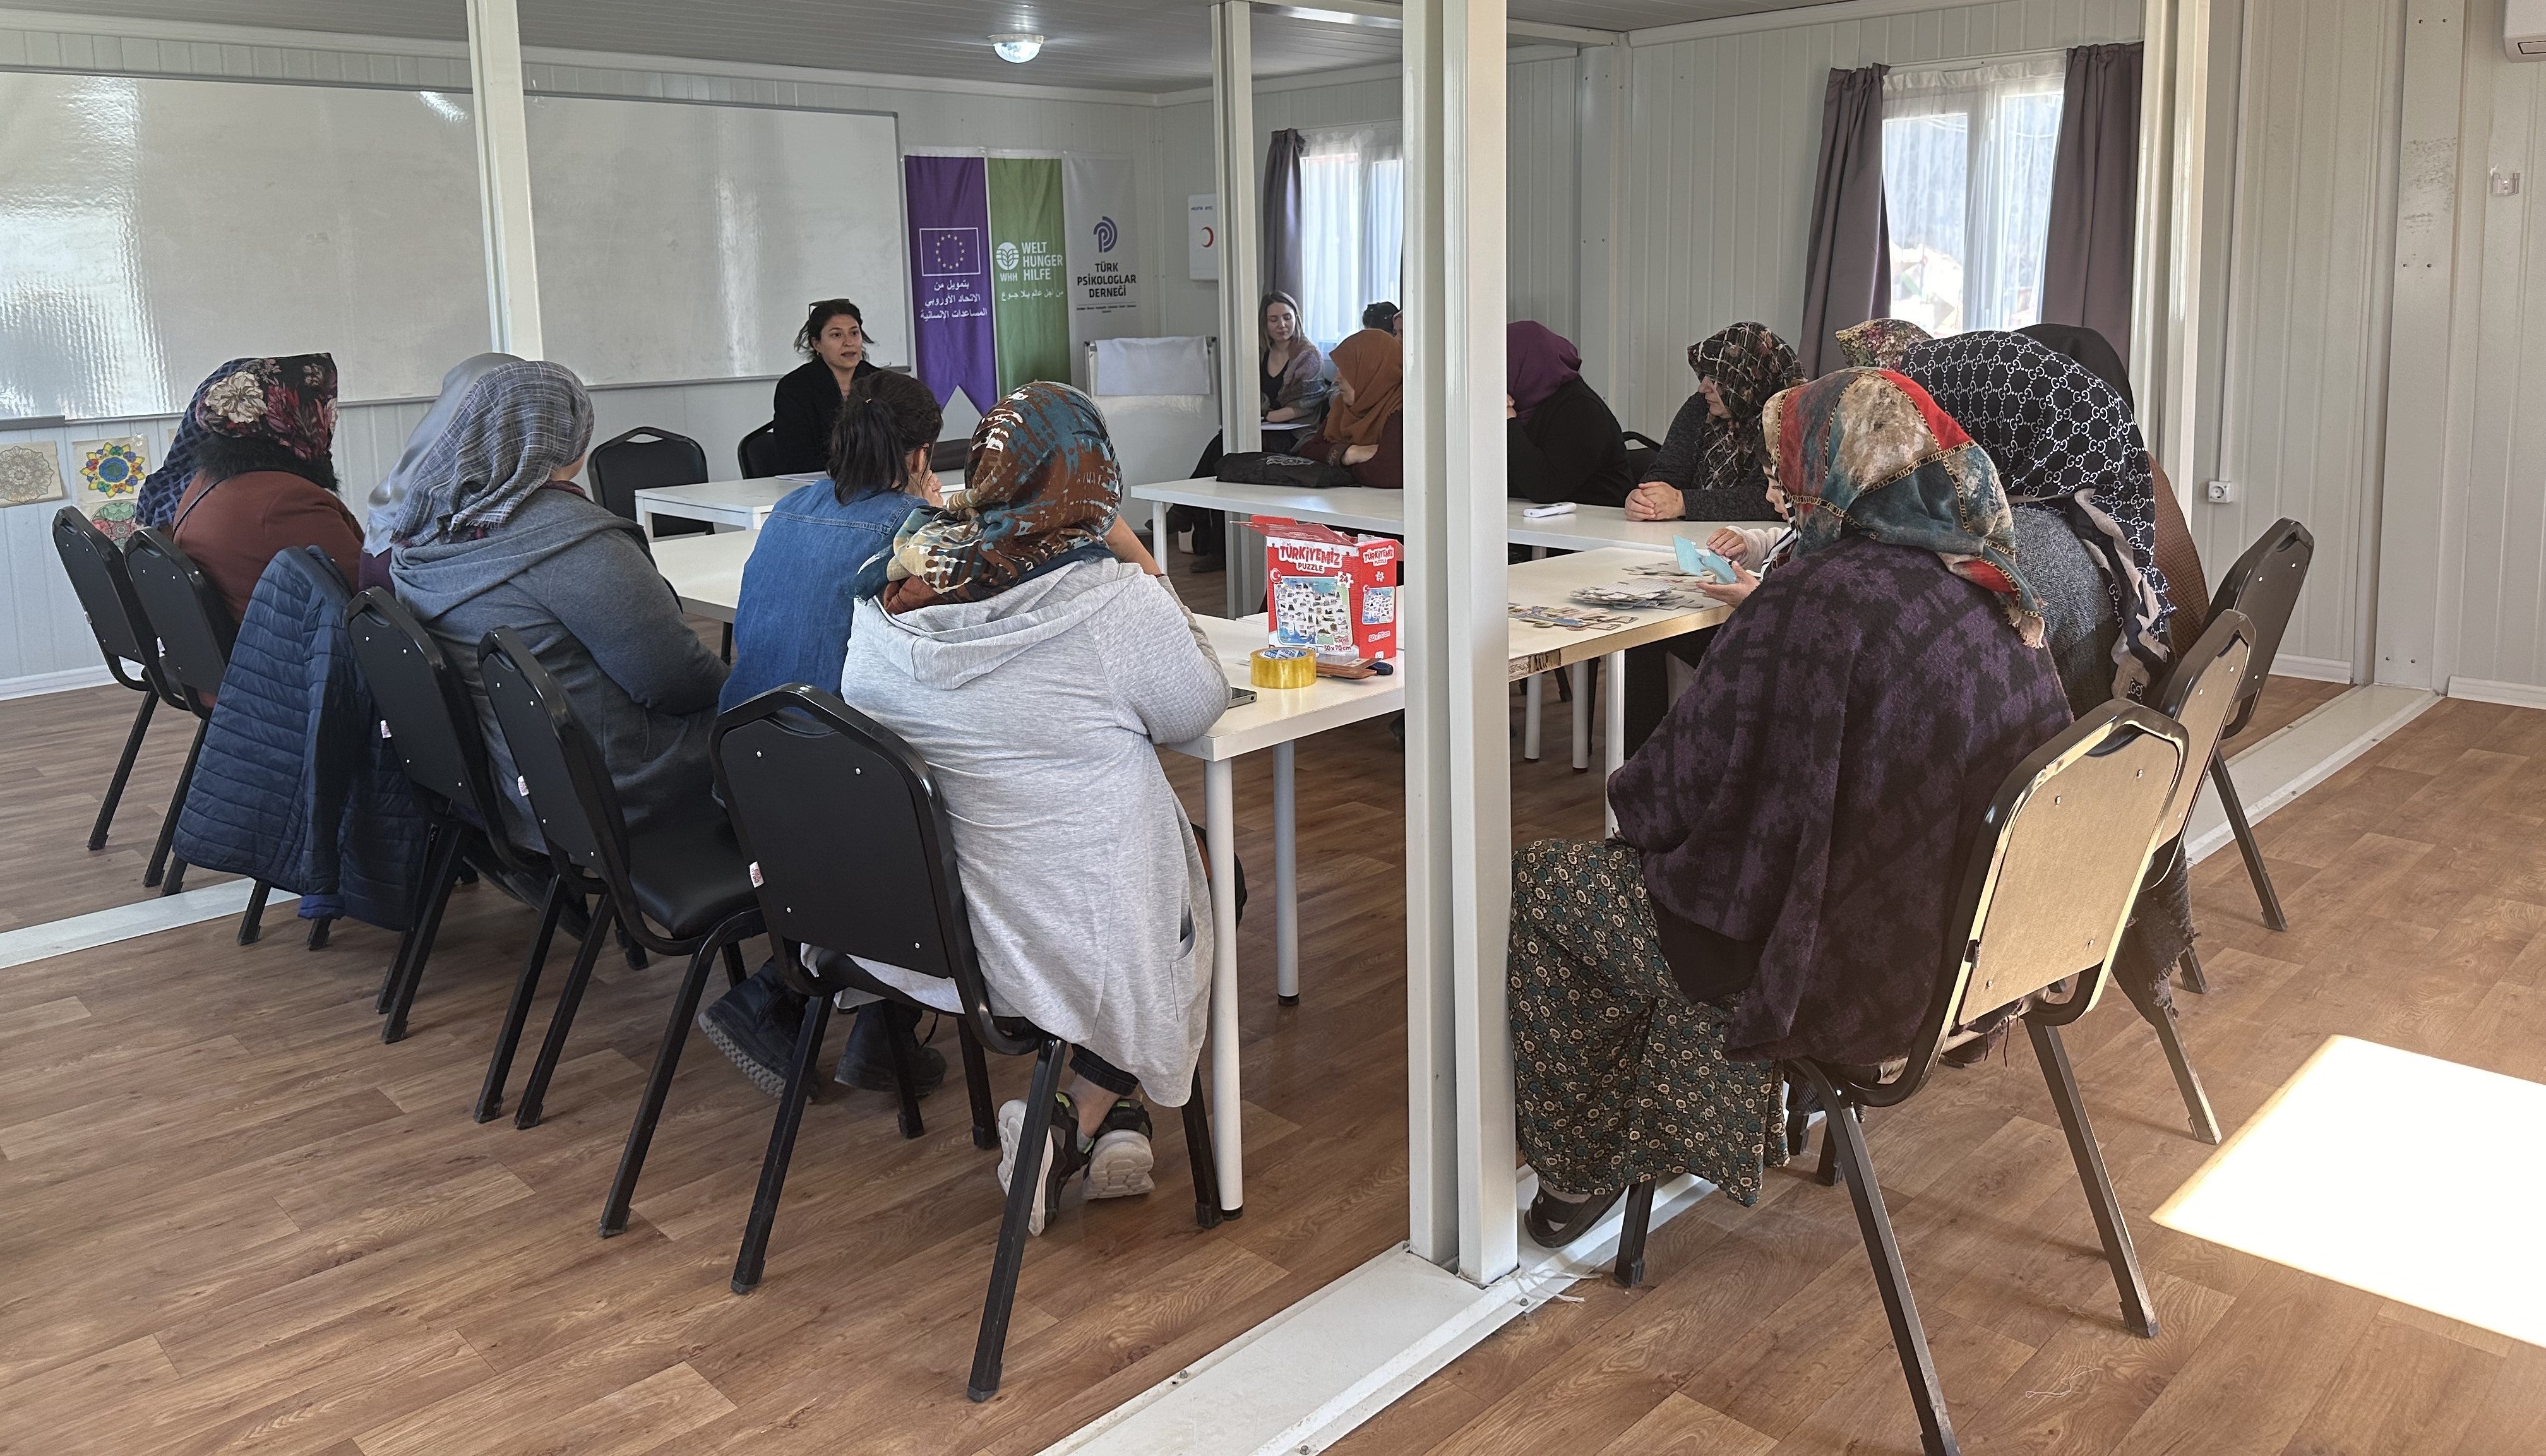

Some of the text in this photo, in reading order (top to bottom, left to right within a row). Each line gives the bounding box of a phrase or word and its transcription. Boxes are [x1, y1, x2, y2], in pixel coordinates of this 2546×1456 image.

[1021, 241, 1047, 254] WELT
[1023, 254, 1063, 268] HUNGER
[1094, 261, 1118, 272] TÜRK
[1000, 272, 1018, 282] WHH
[1024, 268, 1051, 281] HILFE
[1077, 273, 1137, 286] PSİKOLOGLAR
[934, 279, 970, 291] بتمويل من
[1089, 284, 1127, 298] DERNEĞİ
[958, 293, 981, 302] الاتحاد
[1279, 543, 1340, 565] TÜRKİYEMİZ
[1298, 563, 1324, 572] PUZZLE
[1339, 575, 1349, 583] 24
